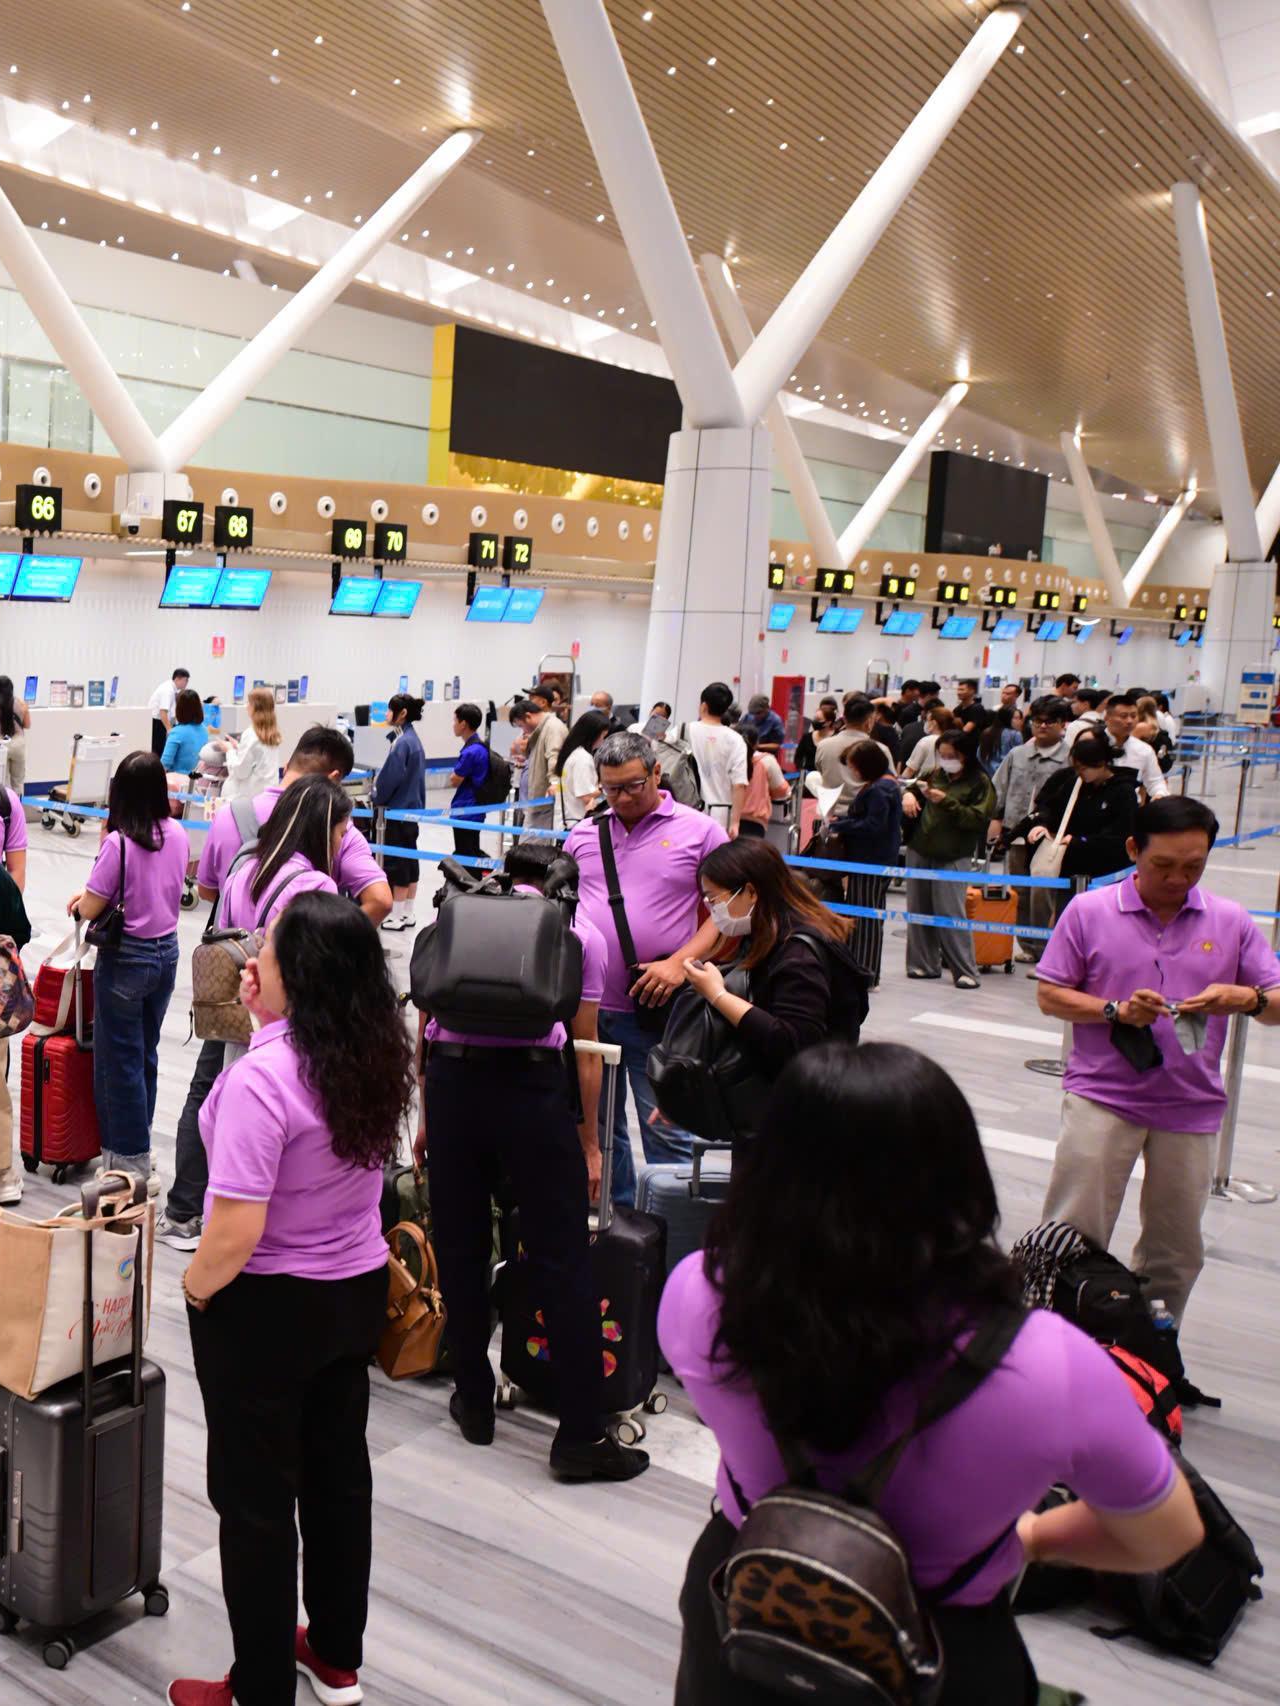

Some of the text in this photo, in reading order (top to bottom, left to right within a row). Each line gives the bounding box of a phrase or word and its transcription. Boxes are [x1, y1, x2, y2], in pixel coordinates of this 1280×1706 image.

[31, 495, 55, 520] 66
[177, 510, 197, 533] 67
[228, 515, 248, 538] 68
[387, 531, 403, 552] 70
[482, 540, 495, 559] 71
[515, 544, 529, 563] 72
[475, 857, 495, 869] ACV
[882, 866, 907, 878] ACV
